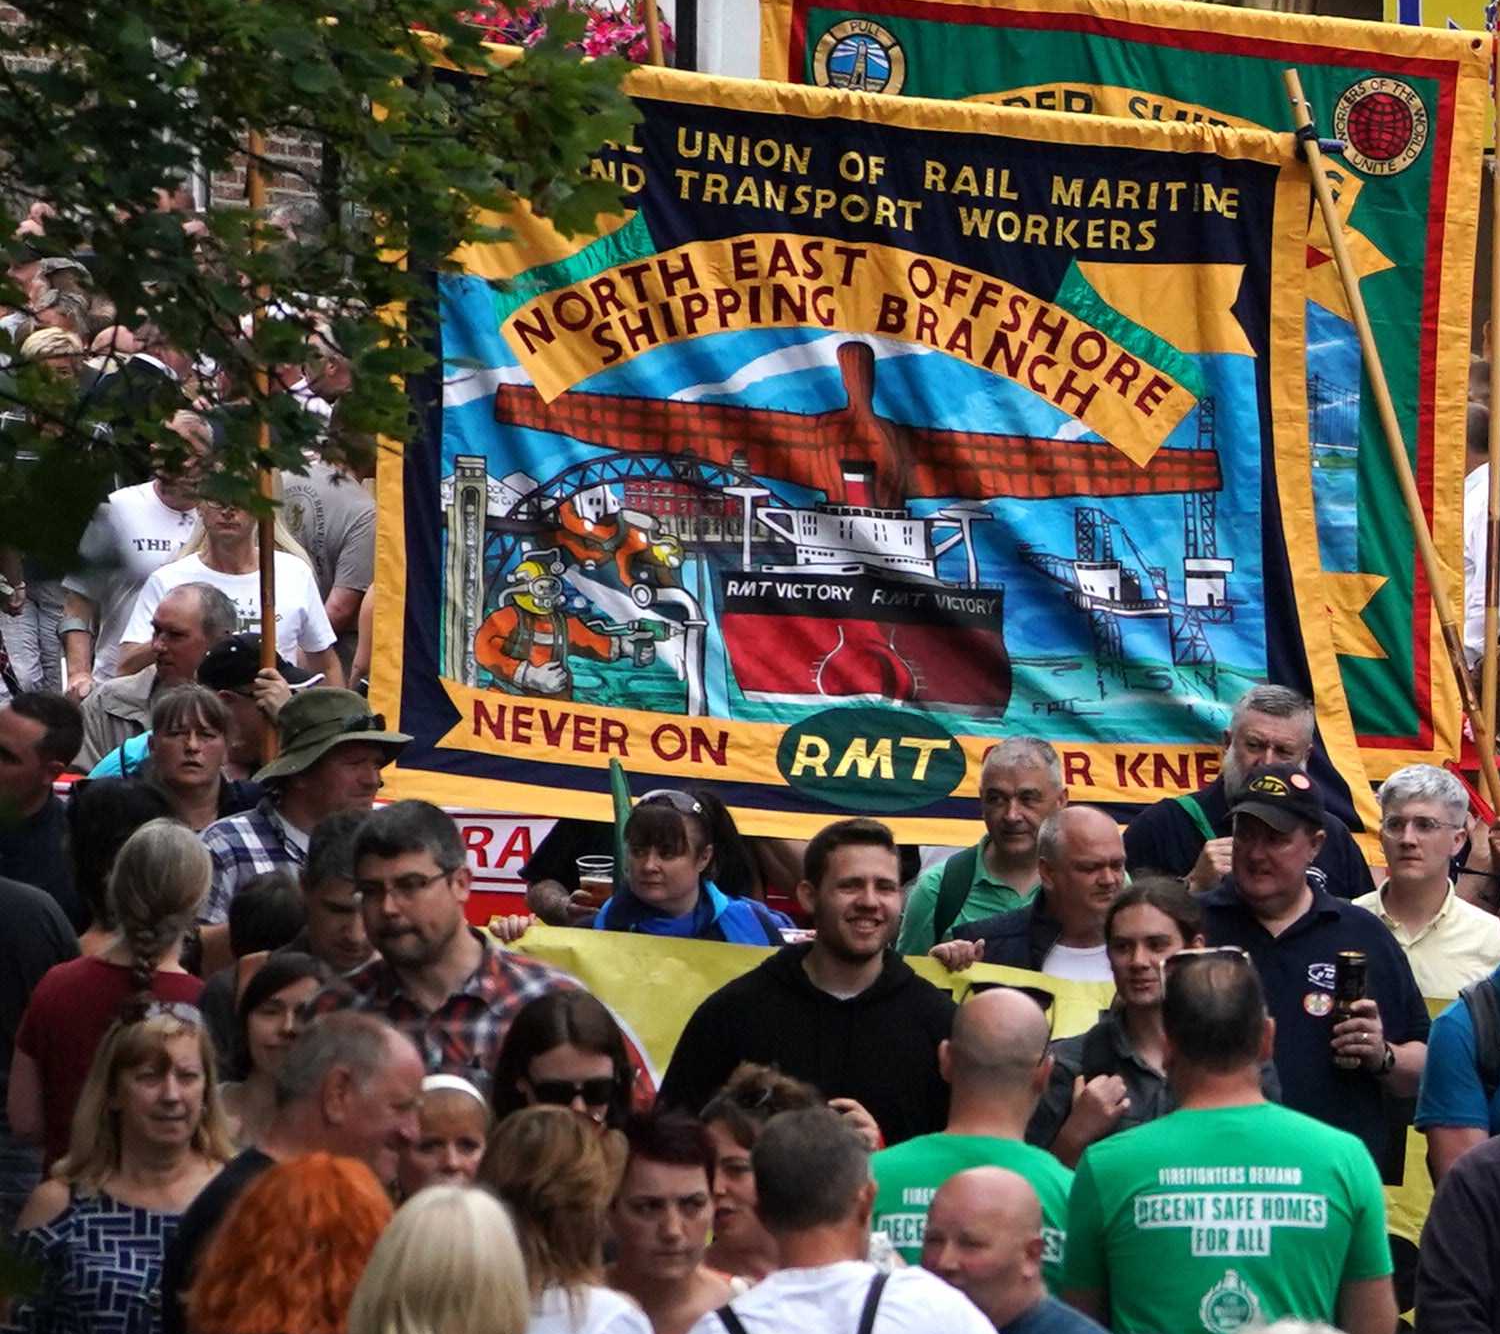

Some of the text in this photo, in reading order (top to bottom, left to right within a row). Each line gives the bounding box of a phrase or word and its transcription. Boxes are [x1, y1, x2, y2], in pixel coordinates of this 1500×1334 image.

[1370, 80, 1388, 91] OF
[1393, 82, 1417, 105] THE
[1405, 107, 1426, 160] WORLD
[677, 126, 811, 175] UNION
[839, 151, 886, 185] OF
[924, 159, 1019, 200] RAIL
[1352, 154, 1397, 174] UNITE
[675, 169, 922, 231] TRANSPORT
[958, 206, 1157, 252] WORKERS
[512, 239, 1174, 417] NORTH EAST OFFSHORE
[592, 284, 1100, 418] SHIPPING BRANCH
[133, 539, 171, 552] THE
[726, 581, 997, 616] RMT VICTORY RMT VICTORY
[472, 699, 729, 766] NEVER ON
[790, 733, 951, 781] RMT
[1138, 1197, 1323, 1224] DECENT SAFE HOMES
[1196, 1228, 1265, 1251] FOR ALL
